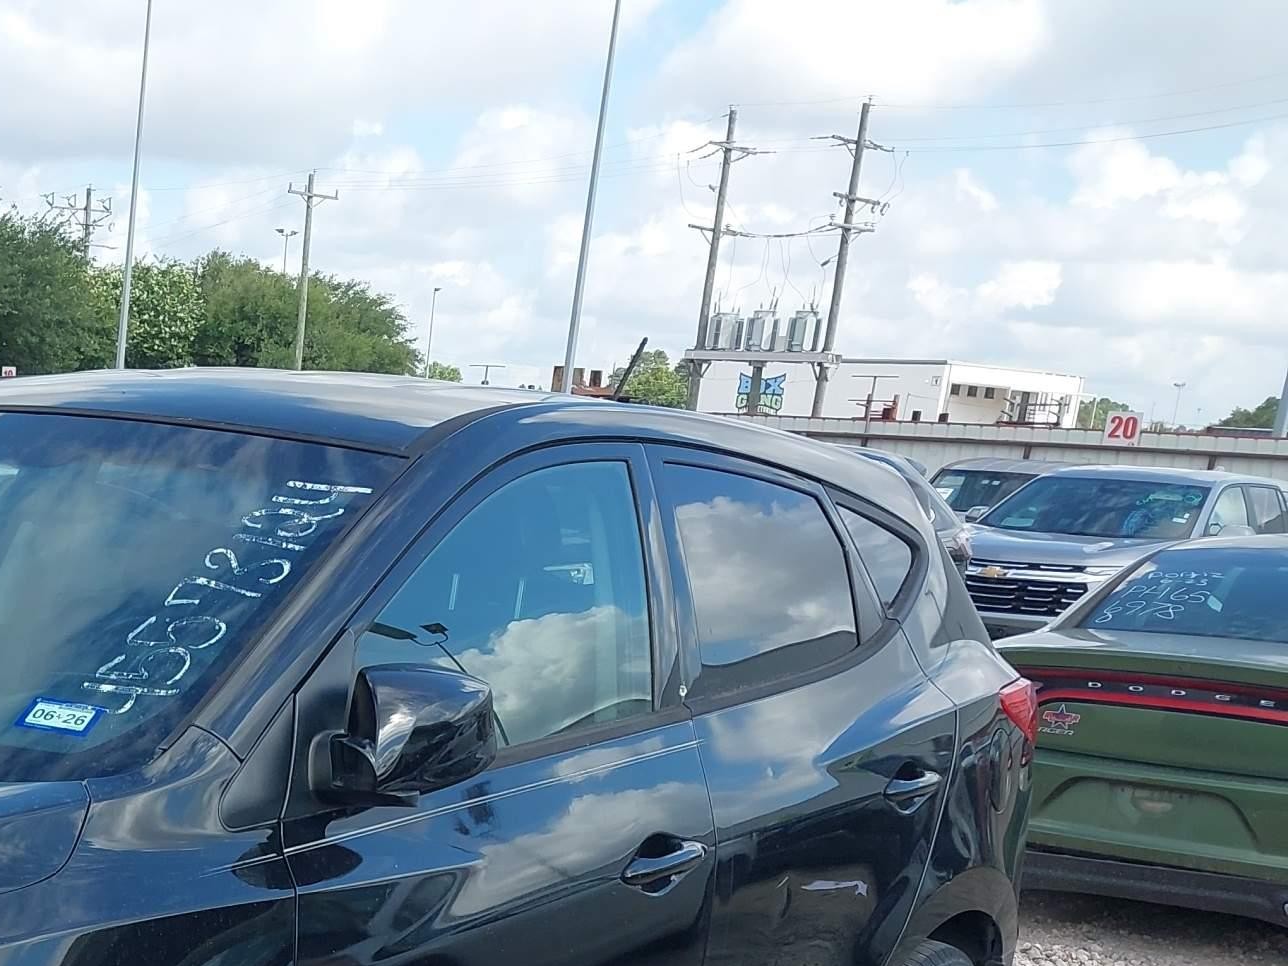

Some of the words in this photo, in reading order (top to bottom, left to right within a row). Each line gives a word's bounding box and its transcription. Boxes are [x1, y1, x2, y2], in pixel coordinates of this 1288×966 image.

[736, 394, 783, 410] GNG
[1108, 416, 1138, 439] 20
[80, 480, 374, 715] 45573124
[1087, 681, 1276, 708] DODGE
